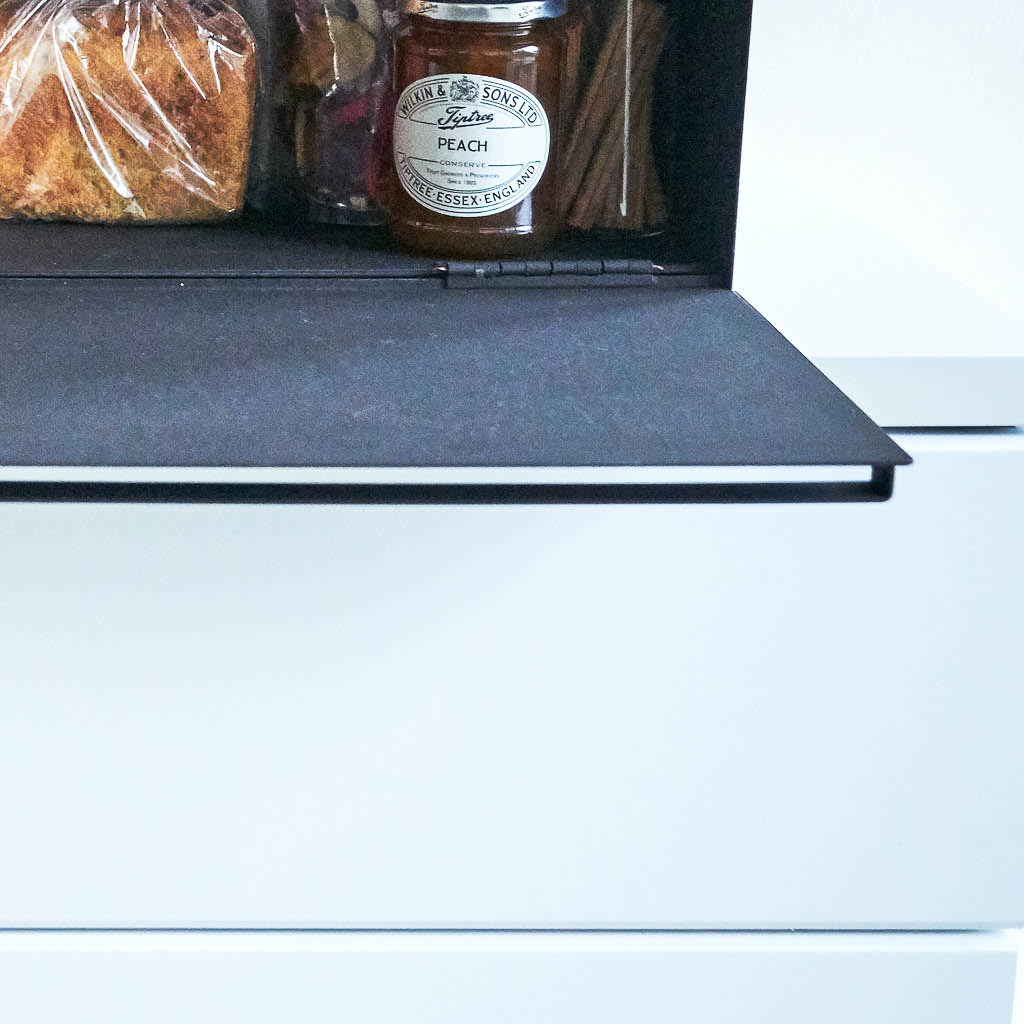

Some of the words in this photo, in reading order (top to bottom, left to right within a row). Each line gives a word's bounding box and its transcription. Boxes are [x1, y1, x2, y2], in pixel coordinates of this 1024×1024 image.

[399, 86, 434, 116] WILKIN
[437, 84, 446, 97] &
[482, 86, 519, 108] SONS
[518, 101, 538, 124] LTD
[437, 106, 494, 129] Tiptree
[438, 137, 488, 152] PEACH
[439, 160, 486, 168] CONSERVE
[399, 155, 432, 198] TIPTREE
[436, 192, 479, 206] ESSEX
[484, 165, 536, 204] ENGLAND
